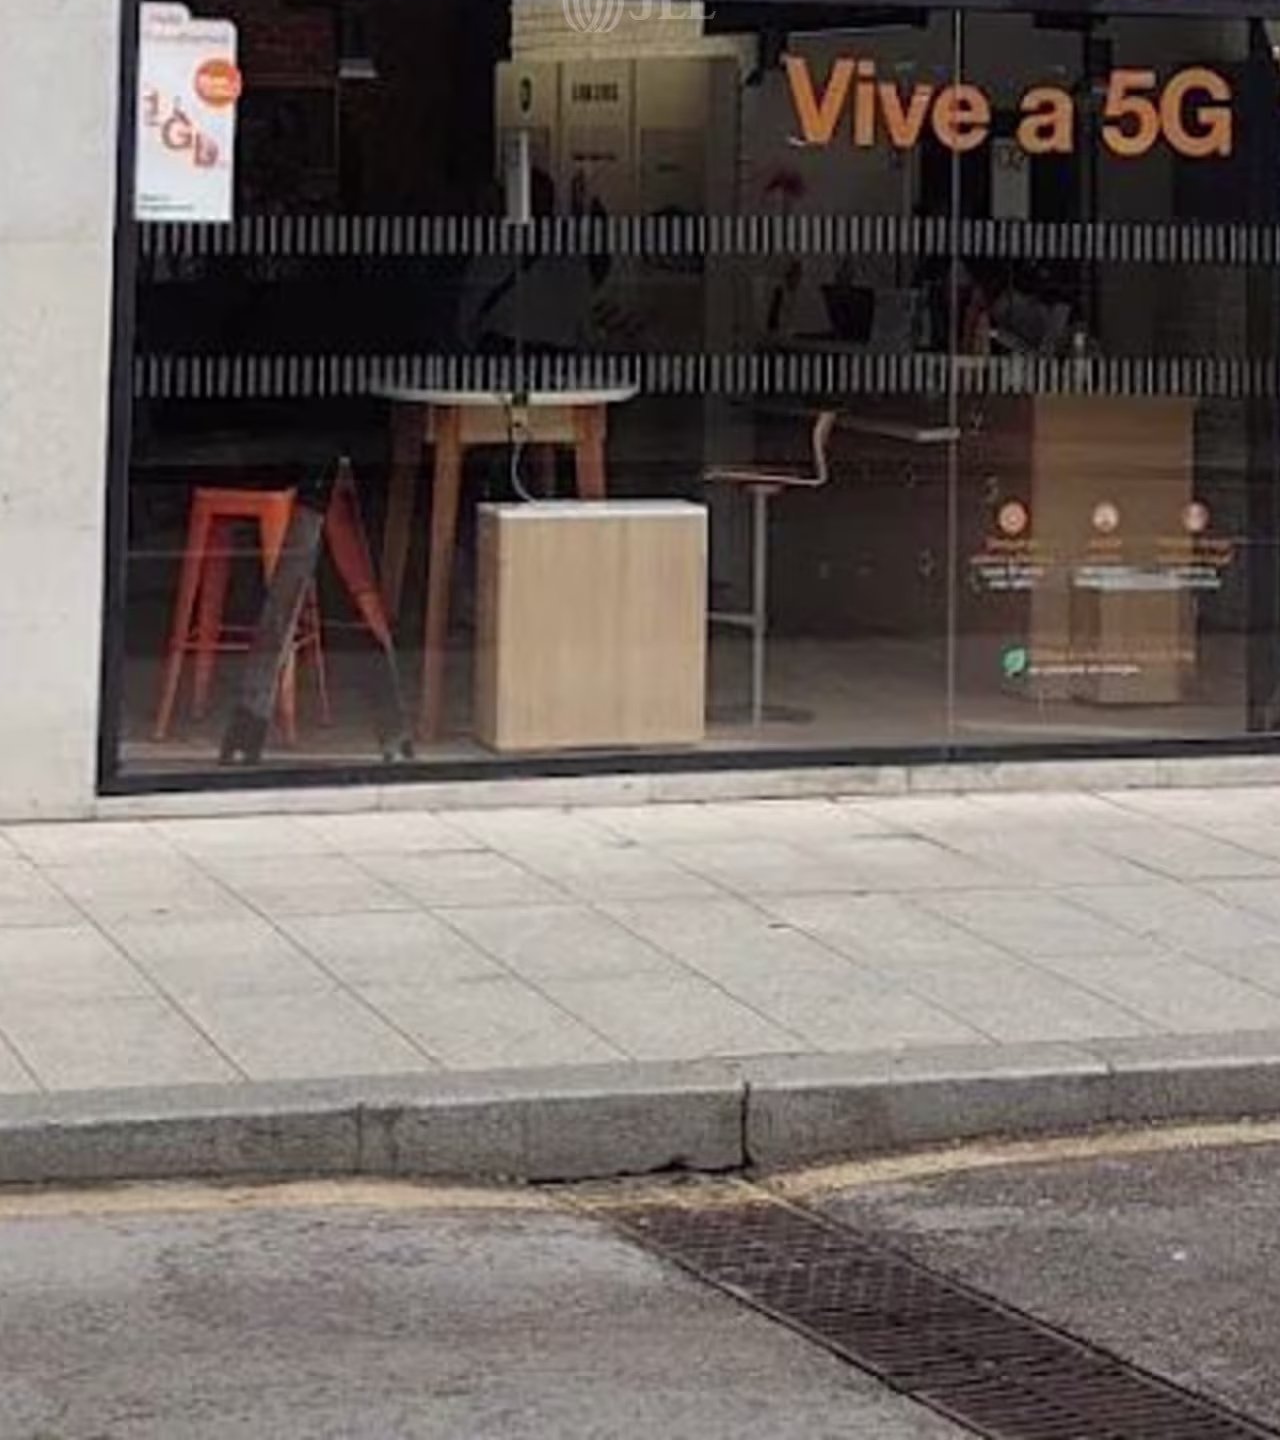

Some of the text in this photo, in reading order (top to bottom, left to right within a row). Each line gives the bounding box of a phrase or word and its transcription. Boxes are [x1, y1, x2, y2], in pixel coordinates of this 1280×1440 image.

[781, 53, 1234, 158] Vive a 5G
